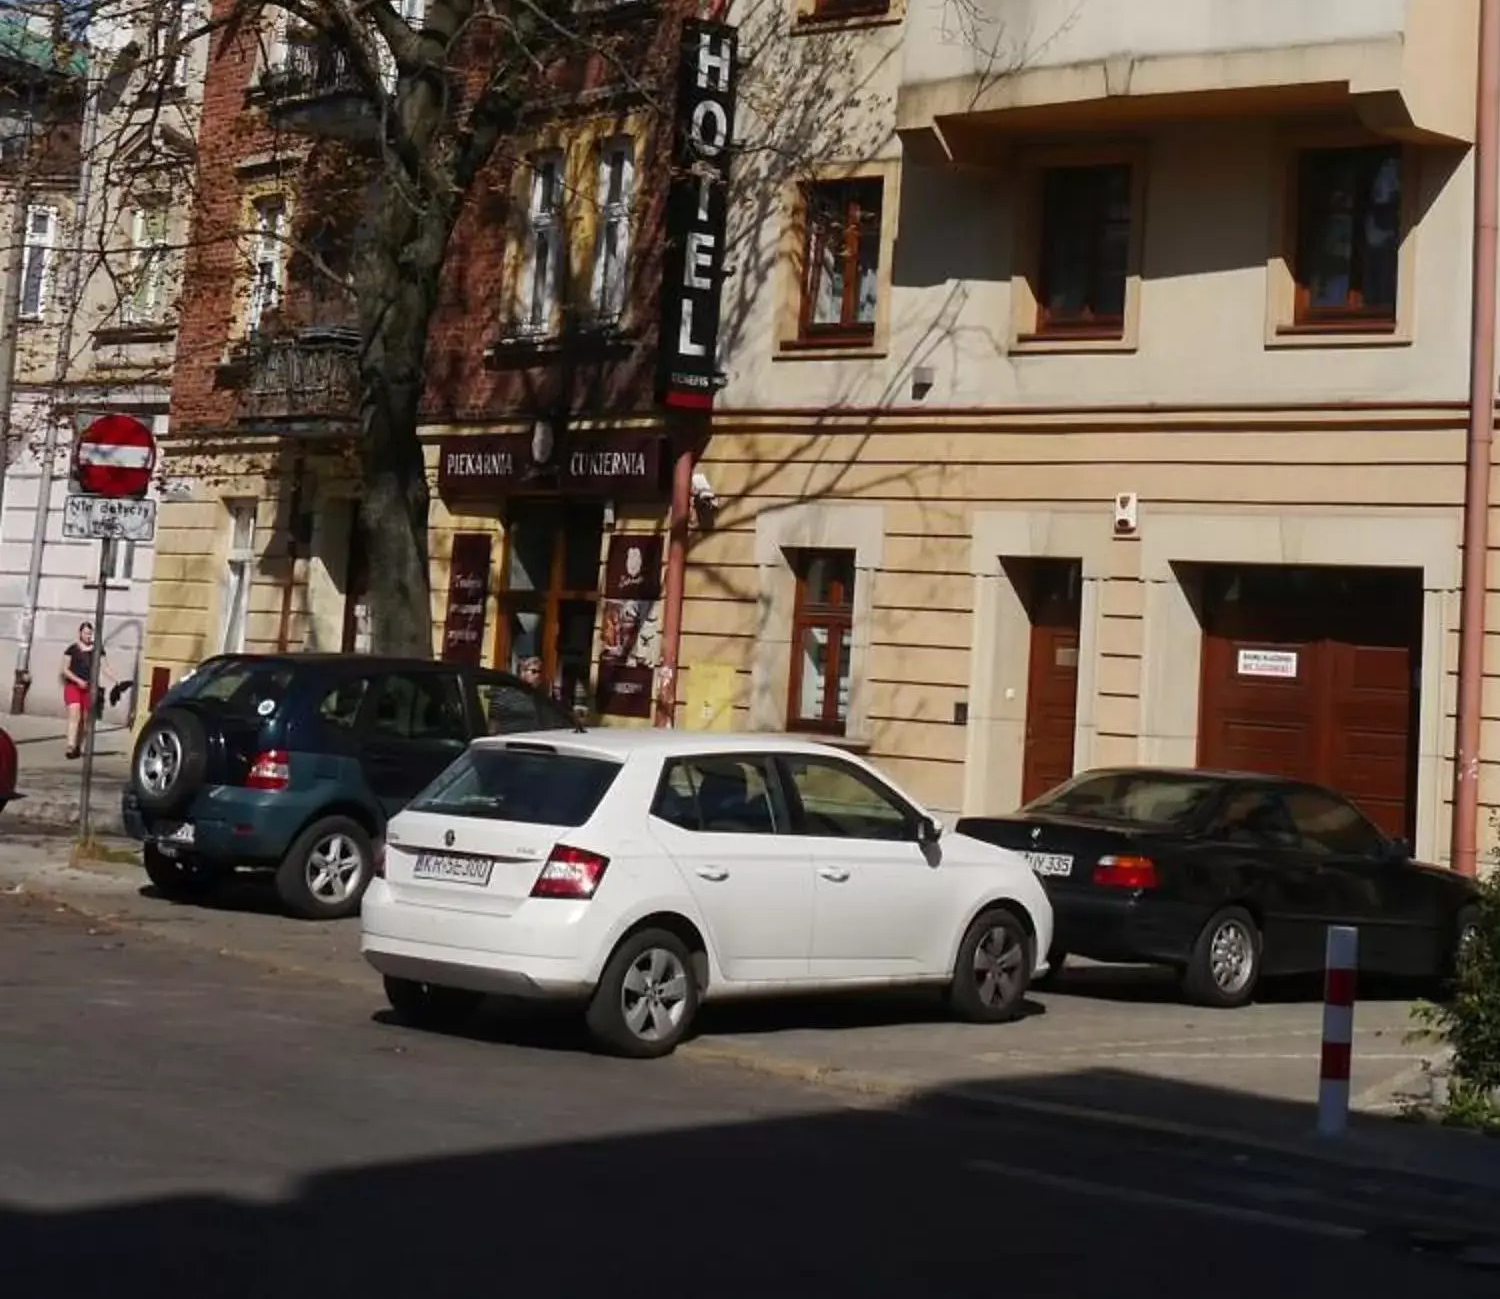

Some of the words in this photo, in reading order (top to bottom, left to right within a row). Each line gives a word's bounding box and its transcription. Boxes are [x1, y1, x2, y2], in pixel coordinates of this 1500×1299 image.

[678, 32, 731, 356] HOTEL
[447, 453, 514, 476] PIEKARNIA
[570, 452, 646, 476] CUKIERNIA
